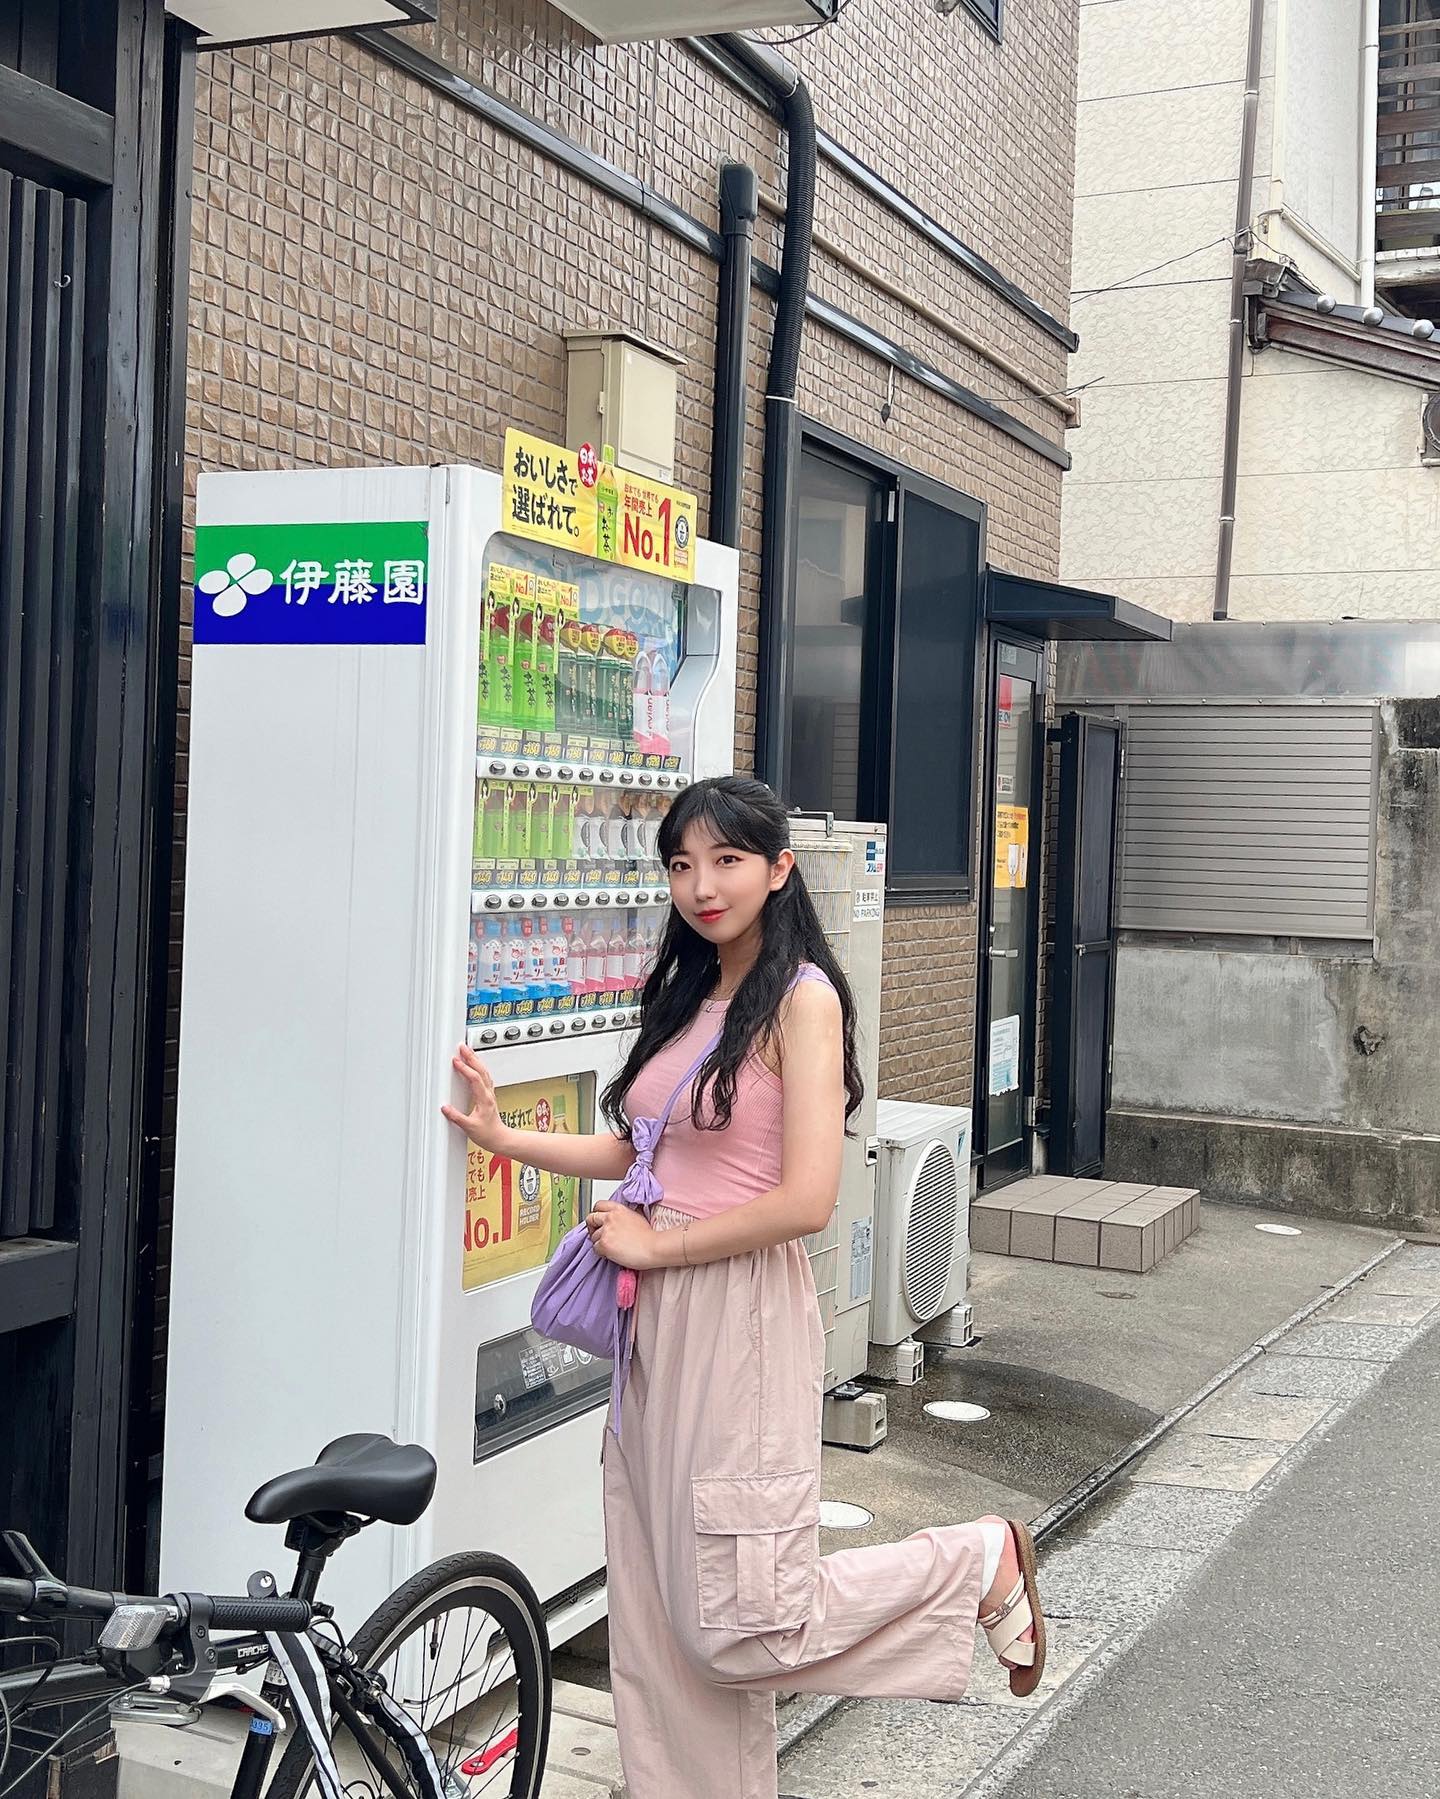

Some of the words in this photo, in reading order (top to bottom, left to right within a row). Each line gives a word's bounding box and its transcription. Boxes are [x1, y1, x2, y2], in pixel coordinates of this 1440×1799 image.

[513, 446, 579, 496] おいしさで
[512, 484, 580, 537] 選ばれて。
[624, 494, 653, 518] 年間売上
[624, 497, 671, 567] No.1
[280, 559, 425, 605] 伊藤園
[466, 1185, 487, 1203] 売上
[519, 1204, 541, 1217] RECORD
[519, 1213, 540, 1226] HOLDER
